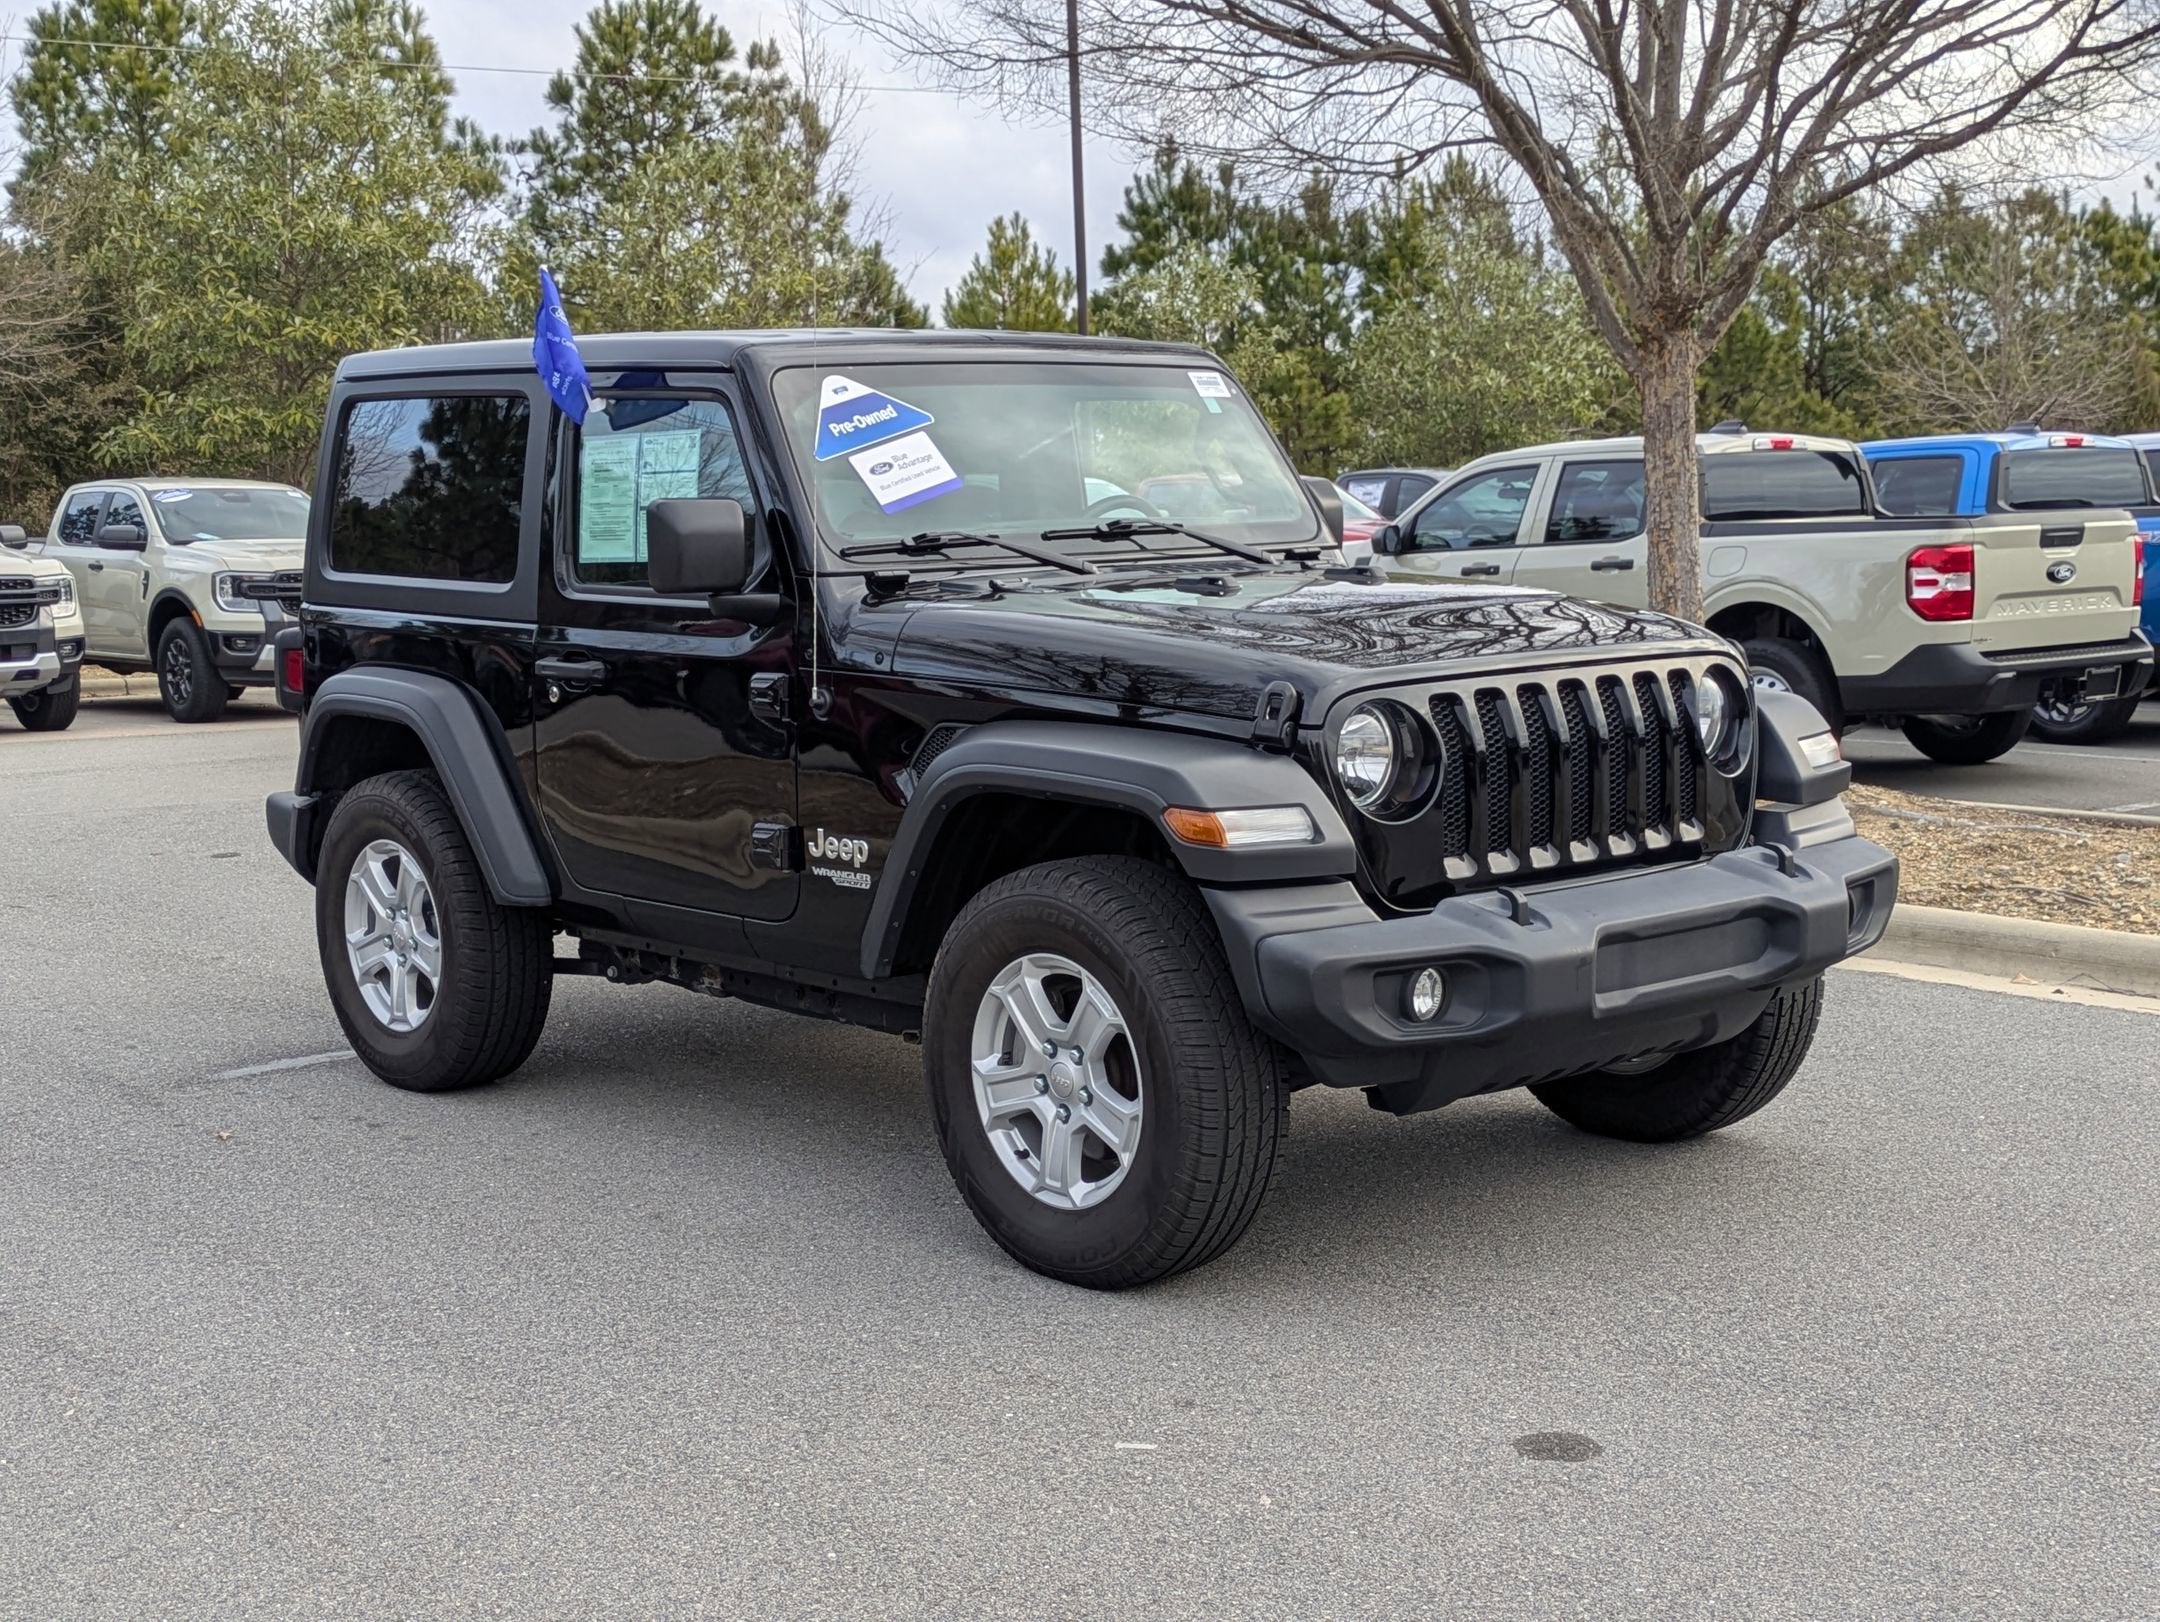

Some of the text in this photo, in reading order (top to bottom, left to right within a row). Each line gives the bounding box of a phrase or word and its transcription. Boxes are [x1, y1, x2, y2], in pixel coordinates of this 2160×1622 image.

[828, 404, 898, 437] Pre-Owned
[891, 453, 908, 463] Blue
[898, 454, 933, 470] Advantage
[871, 462, 892, 475] Ford
[1997, 596, 2112, 617] MAVERICK
[808, 828, 869, 868] Jeep
[811, 866, 871, 881] WRANGLER
